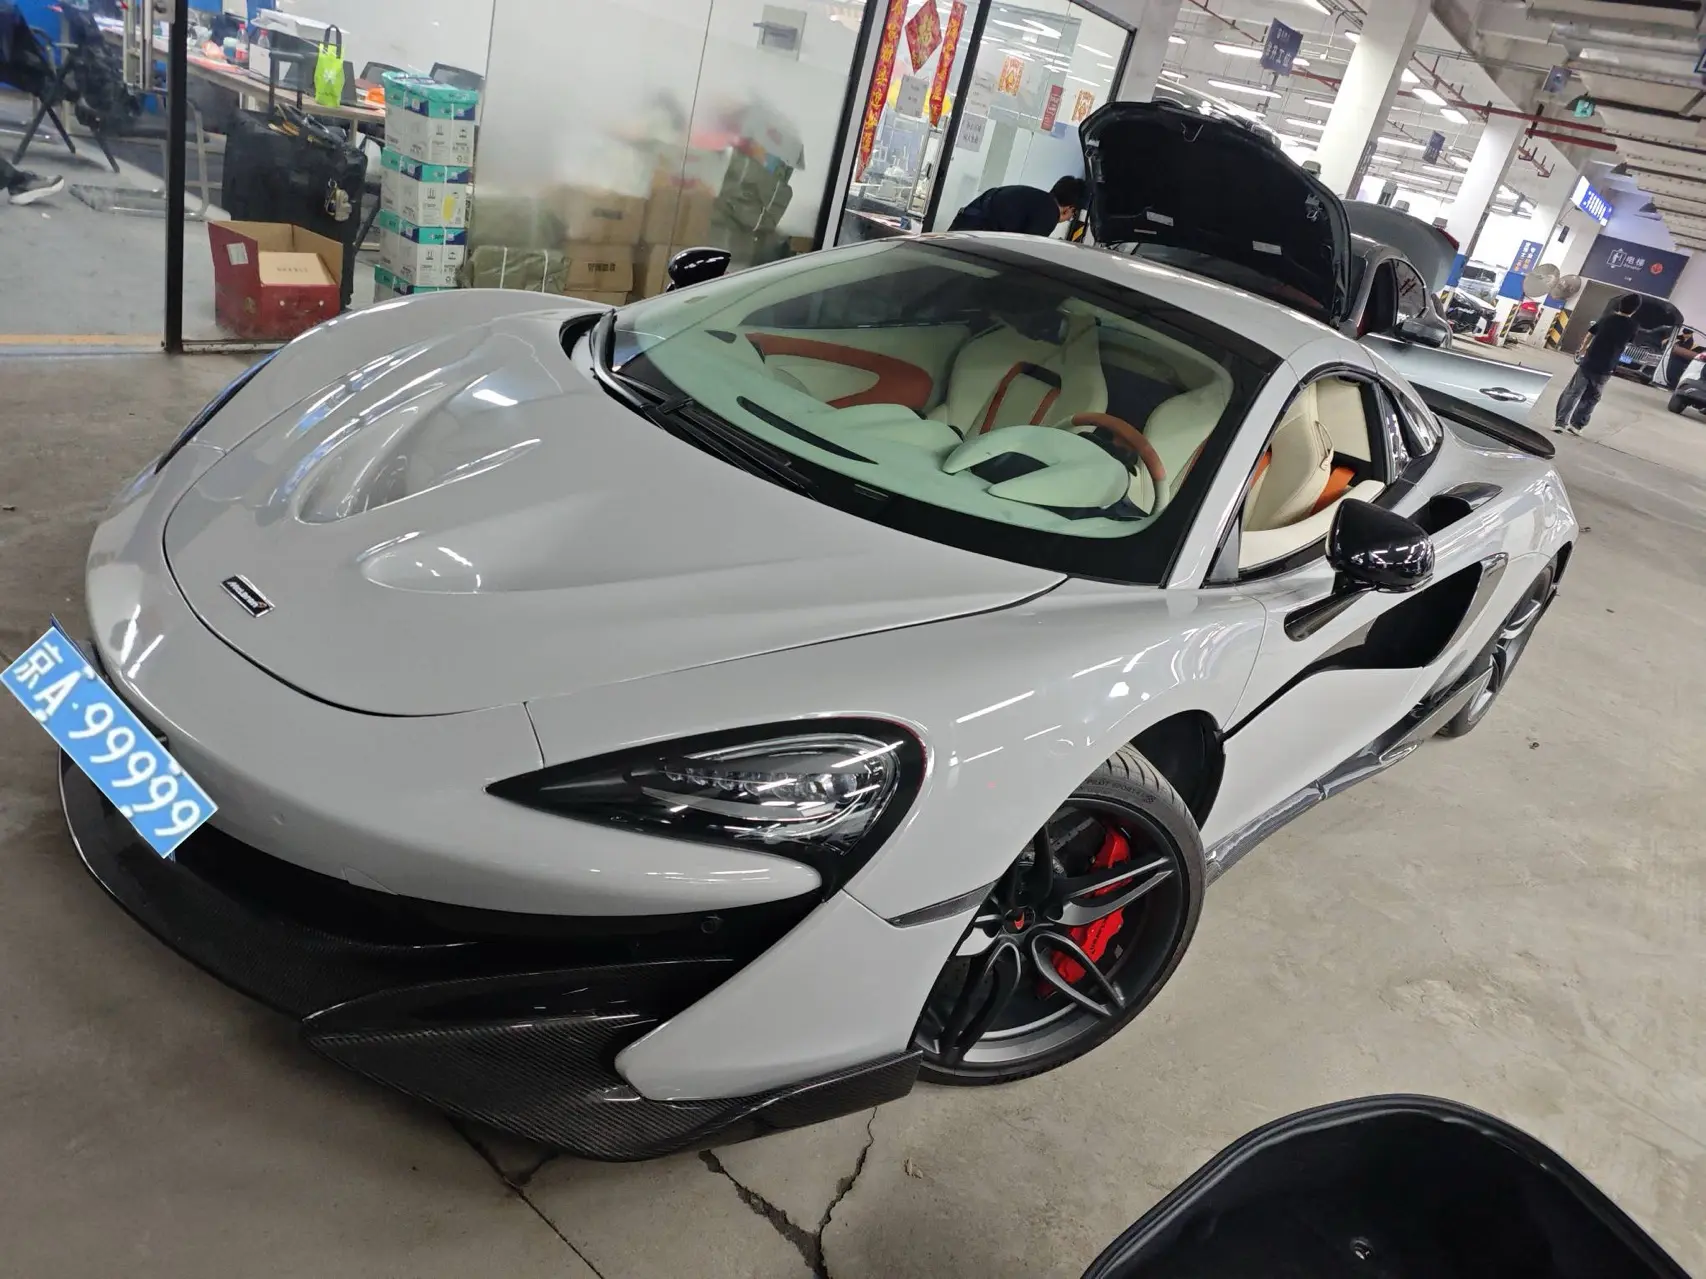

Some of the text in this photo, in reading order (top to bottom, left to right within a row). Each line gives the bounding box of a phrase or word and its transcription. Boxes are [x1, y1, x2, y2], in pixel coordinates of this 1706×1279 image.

[1625, 255, 1646, 267] 电梯
[227, 580, 259, 609] McLaren
[11, 641, 202, 838] 京A·99999
